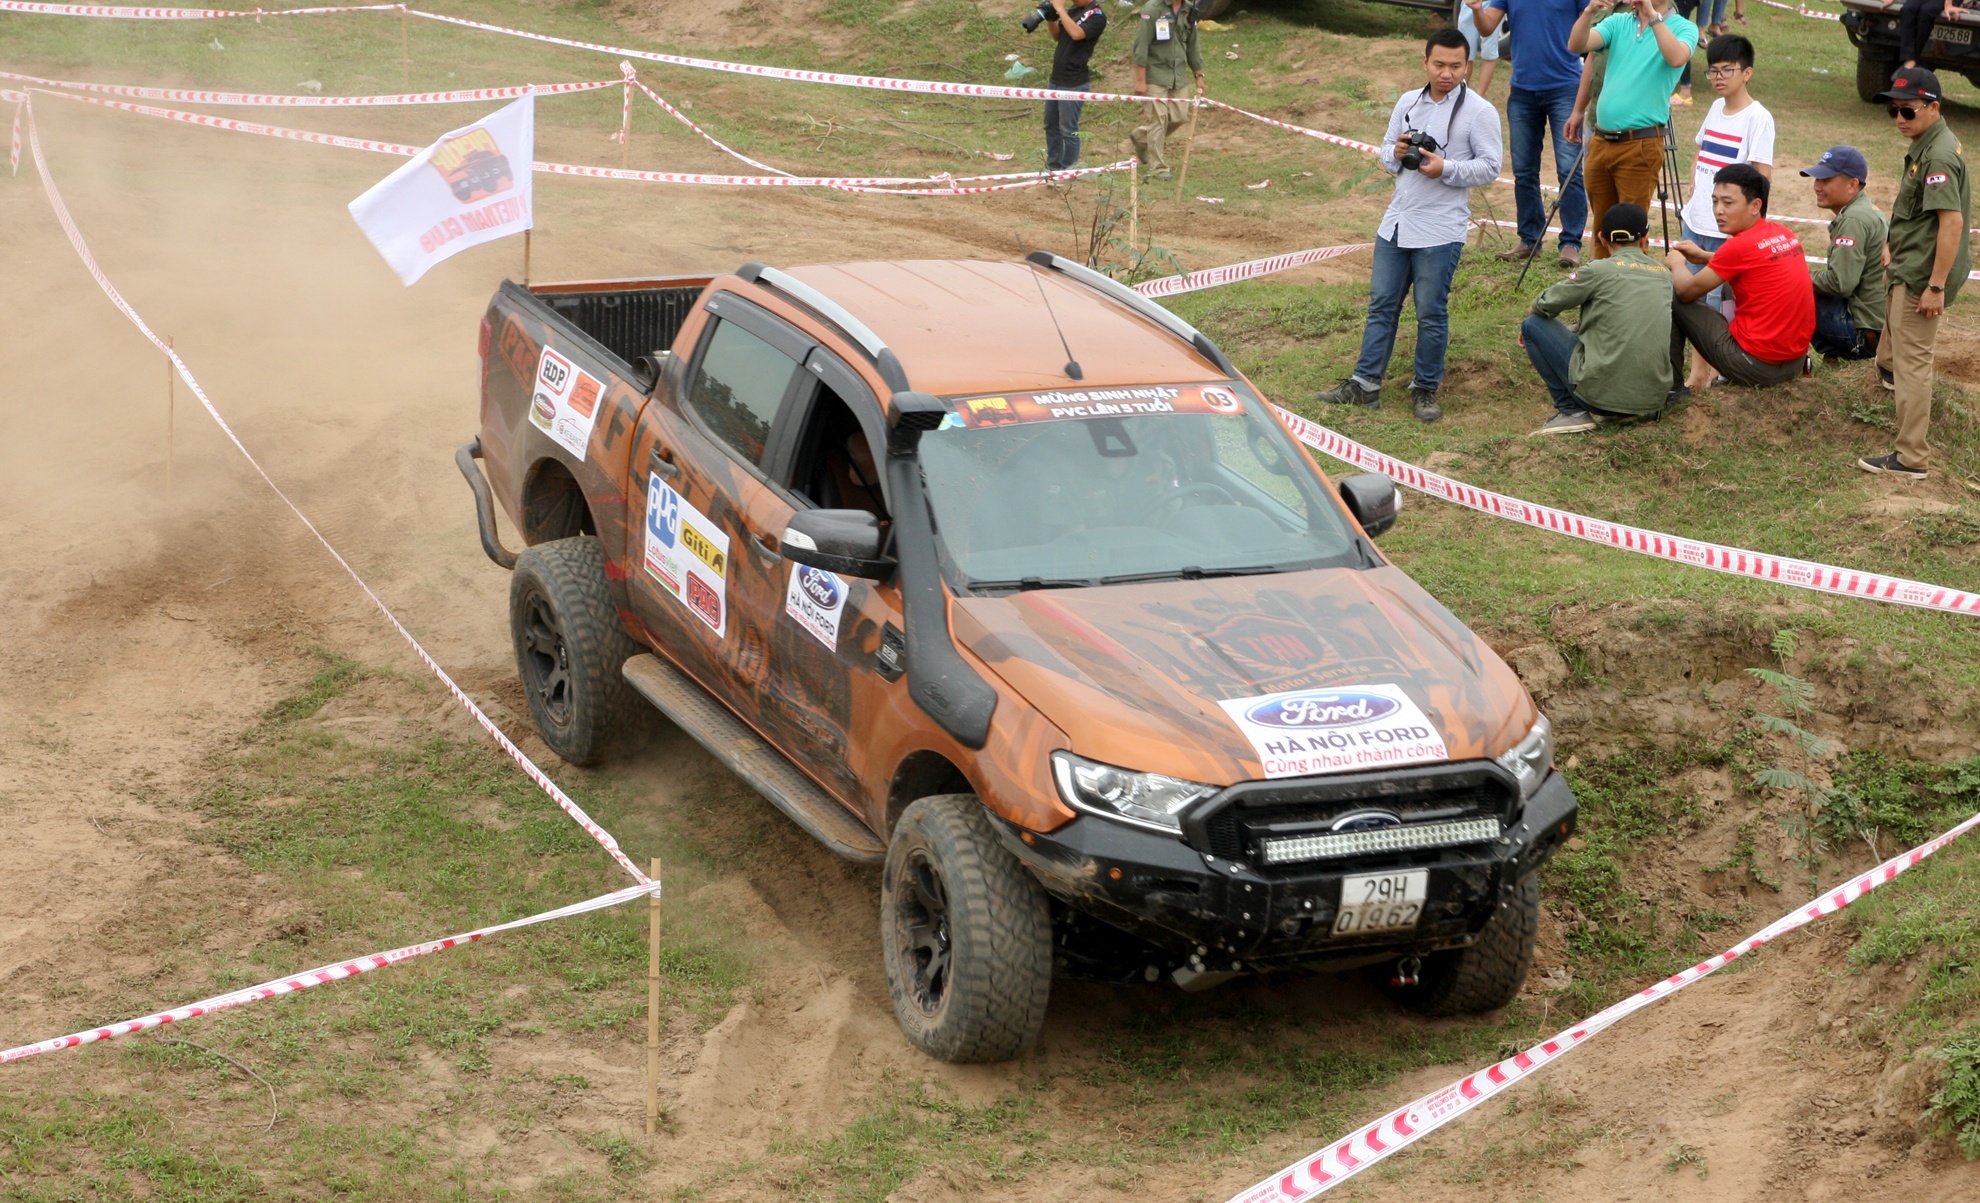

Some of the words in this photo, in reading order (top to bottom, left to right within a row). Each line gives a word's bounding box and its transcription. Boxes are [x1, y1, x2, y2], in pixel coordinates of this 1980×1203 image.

[542, 358, 566, 387] HDP
[1032, 391, 1089, 405] MỪNG
[1087, 389, 1133, 401] SINH
[1131, 386, 1179, 400] NHẬT
[1050, 405, 1089, 418] PVC
[1086, 402, 1122, 416] LÊN
[1122, 403, 1134, 413] 5
[1132, 396, 1175, 413] TUỔI
[1203, 391, 1233, 408] 03
[649, 485, 678, 535] PPG
[682, 527, 709, 563] Giti
[689, 579, 719, 621] PAC
[803, 567, 834, 605] Ford
[815, 611, 835, 637] FORD
[1278, 695, 1375, 725] Ford
[1264, 735, 1308, 756] HÀ
[1307, 730, 1361, 752] NỘI
[1359, 726, 1431, 745] FORD
[1264, 755, 1309, 775] Cùng
[1312, 753, 1353, 770] nhau
[1356, 745, 1404, 764] thành
[1406, 742, 1446, 760] công
[1364, 876, 1408, 904] 29H
